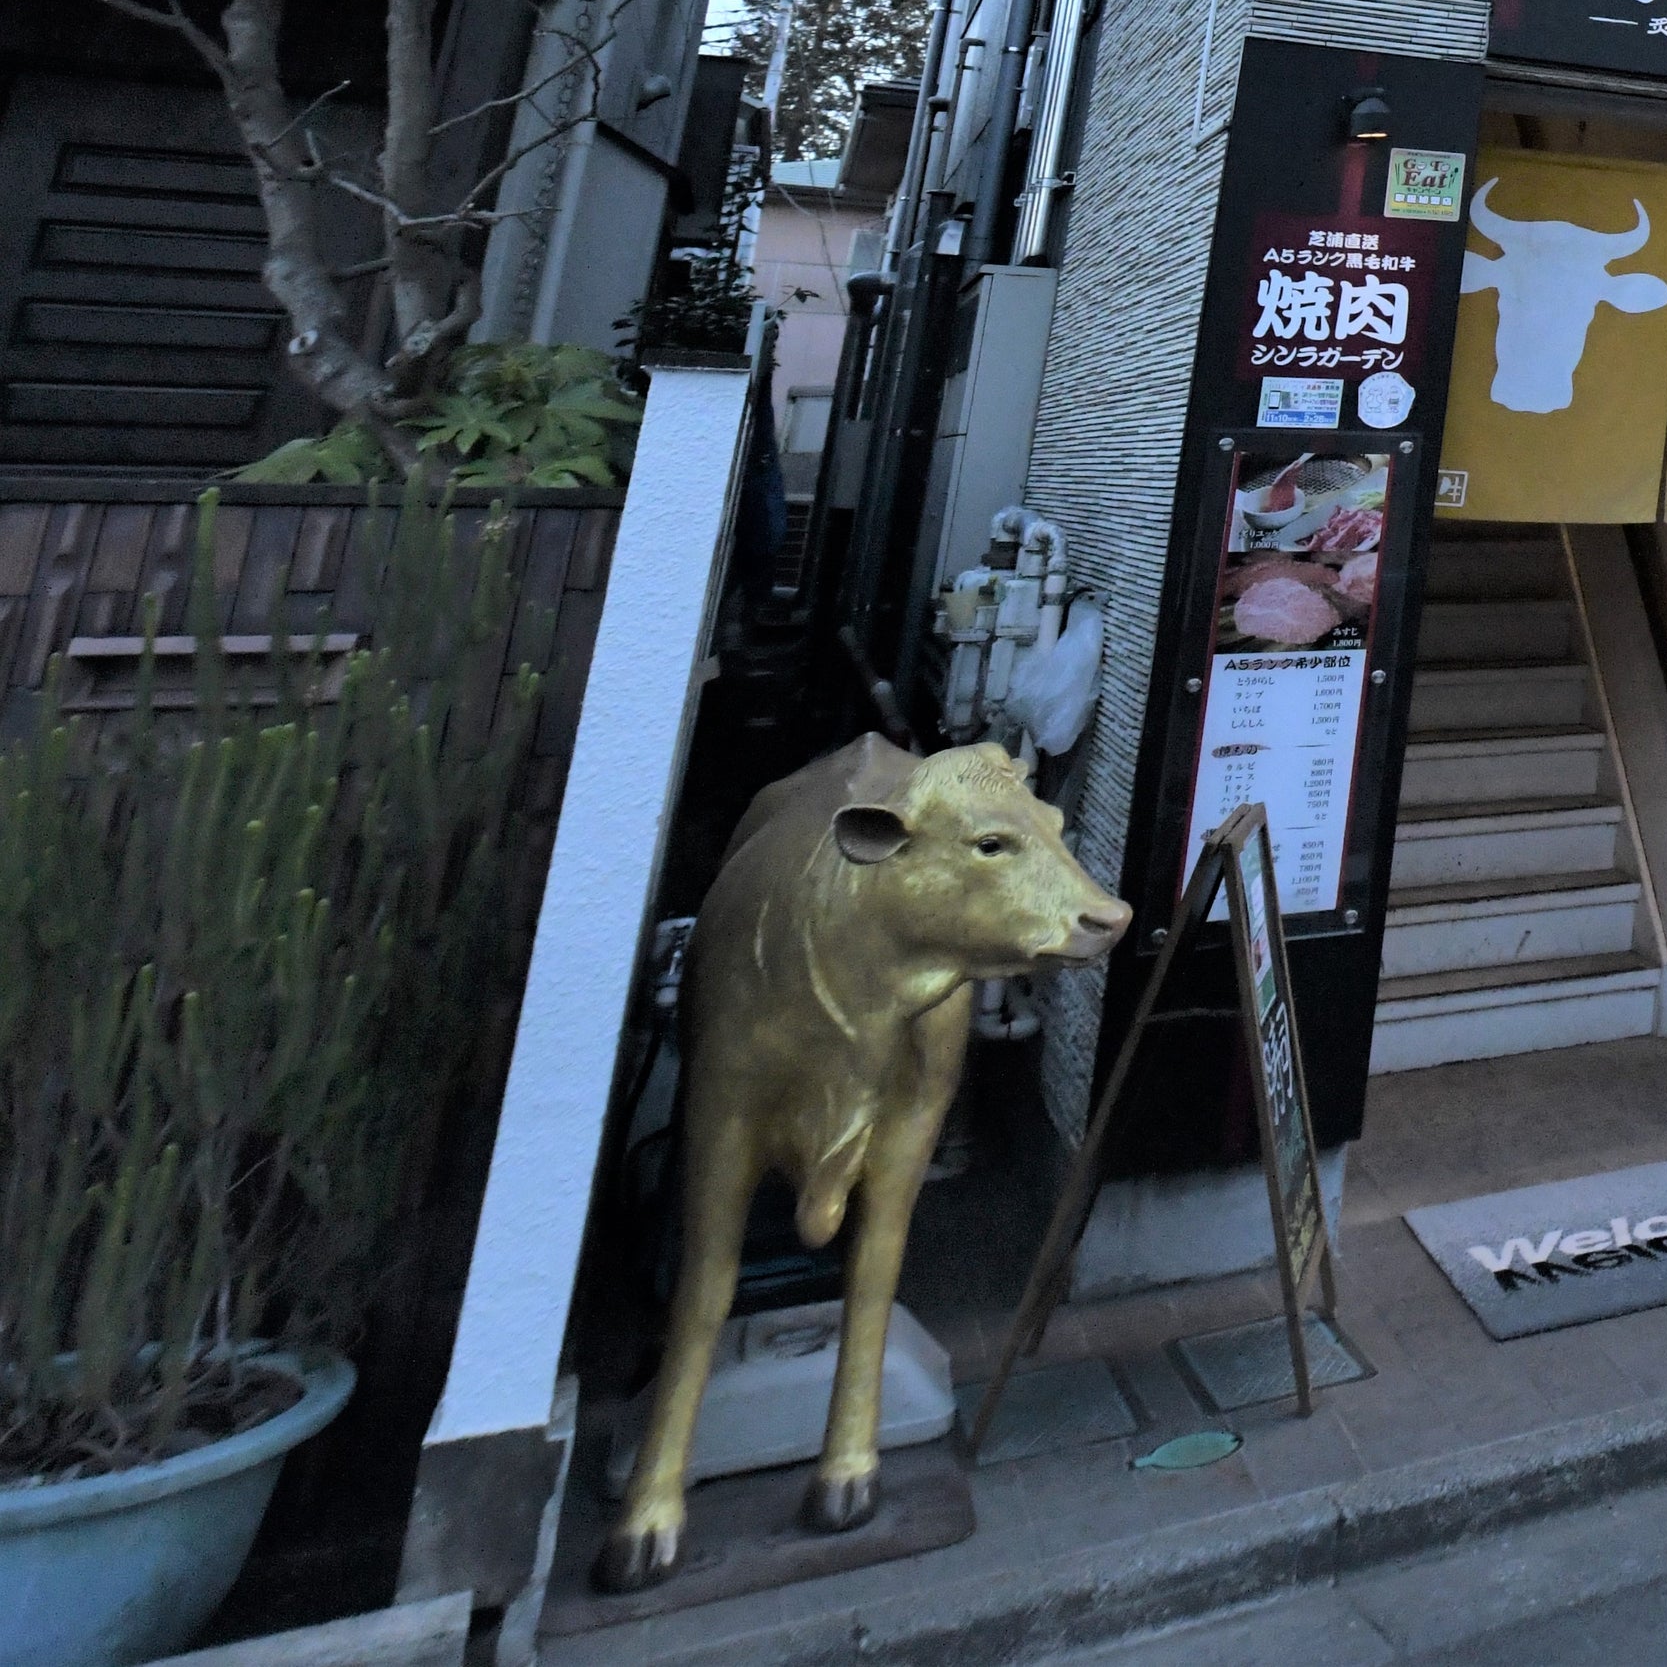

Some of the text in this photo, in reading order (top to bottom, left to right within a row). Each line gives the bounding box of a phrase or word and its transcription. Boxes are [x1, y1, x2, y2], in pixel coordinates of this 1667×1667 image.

[1401, 170, 1448, 189] Eat
[1307, 230, 1380, 251] 芝浦直送
[1262, 247, 1417, 273] A5ランク黒毛和牛
[1251, 269, 1410, 346] 焼肉
[1250, 344, 1405, 371] シンラガーデン
[1224, 655, 1352, 671] A5ランク希少部位
